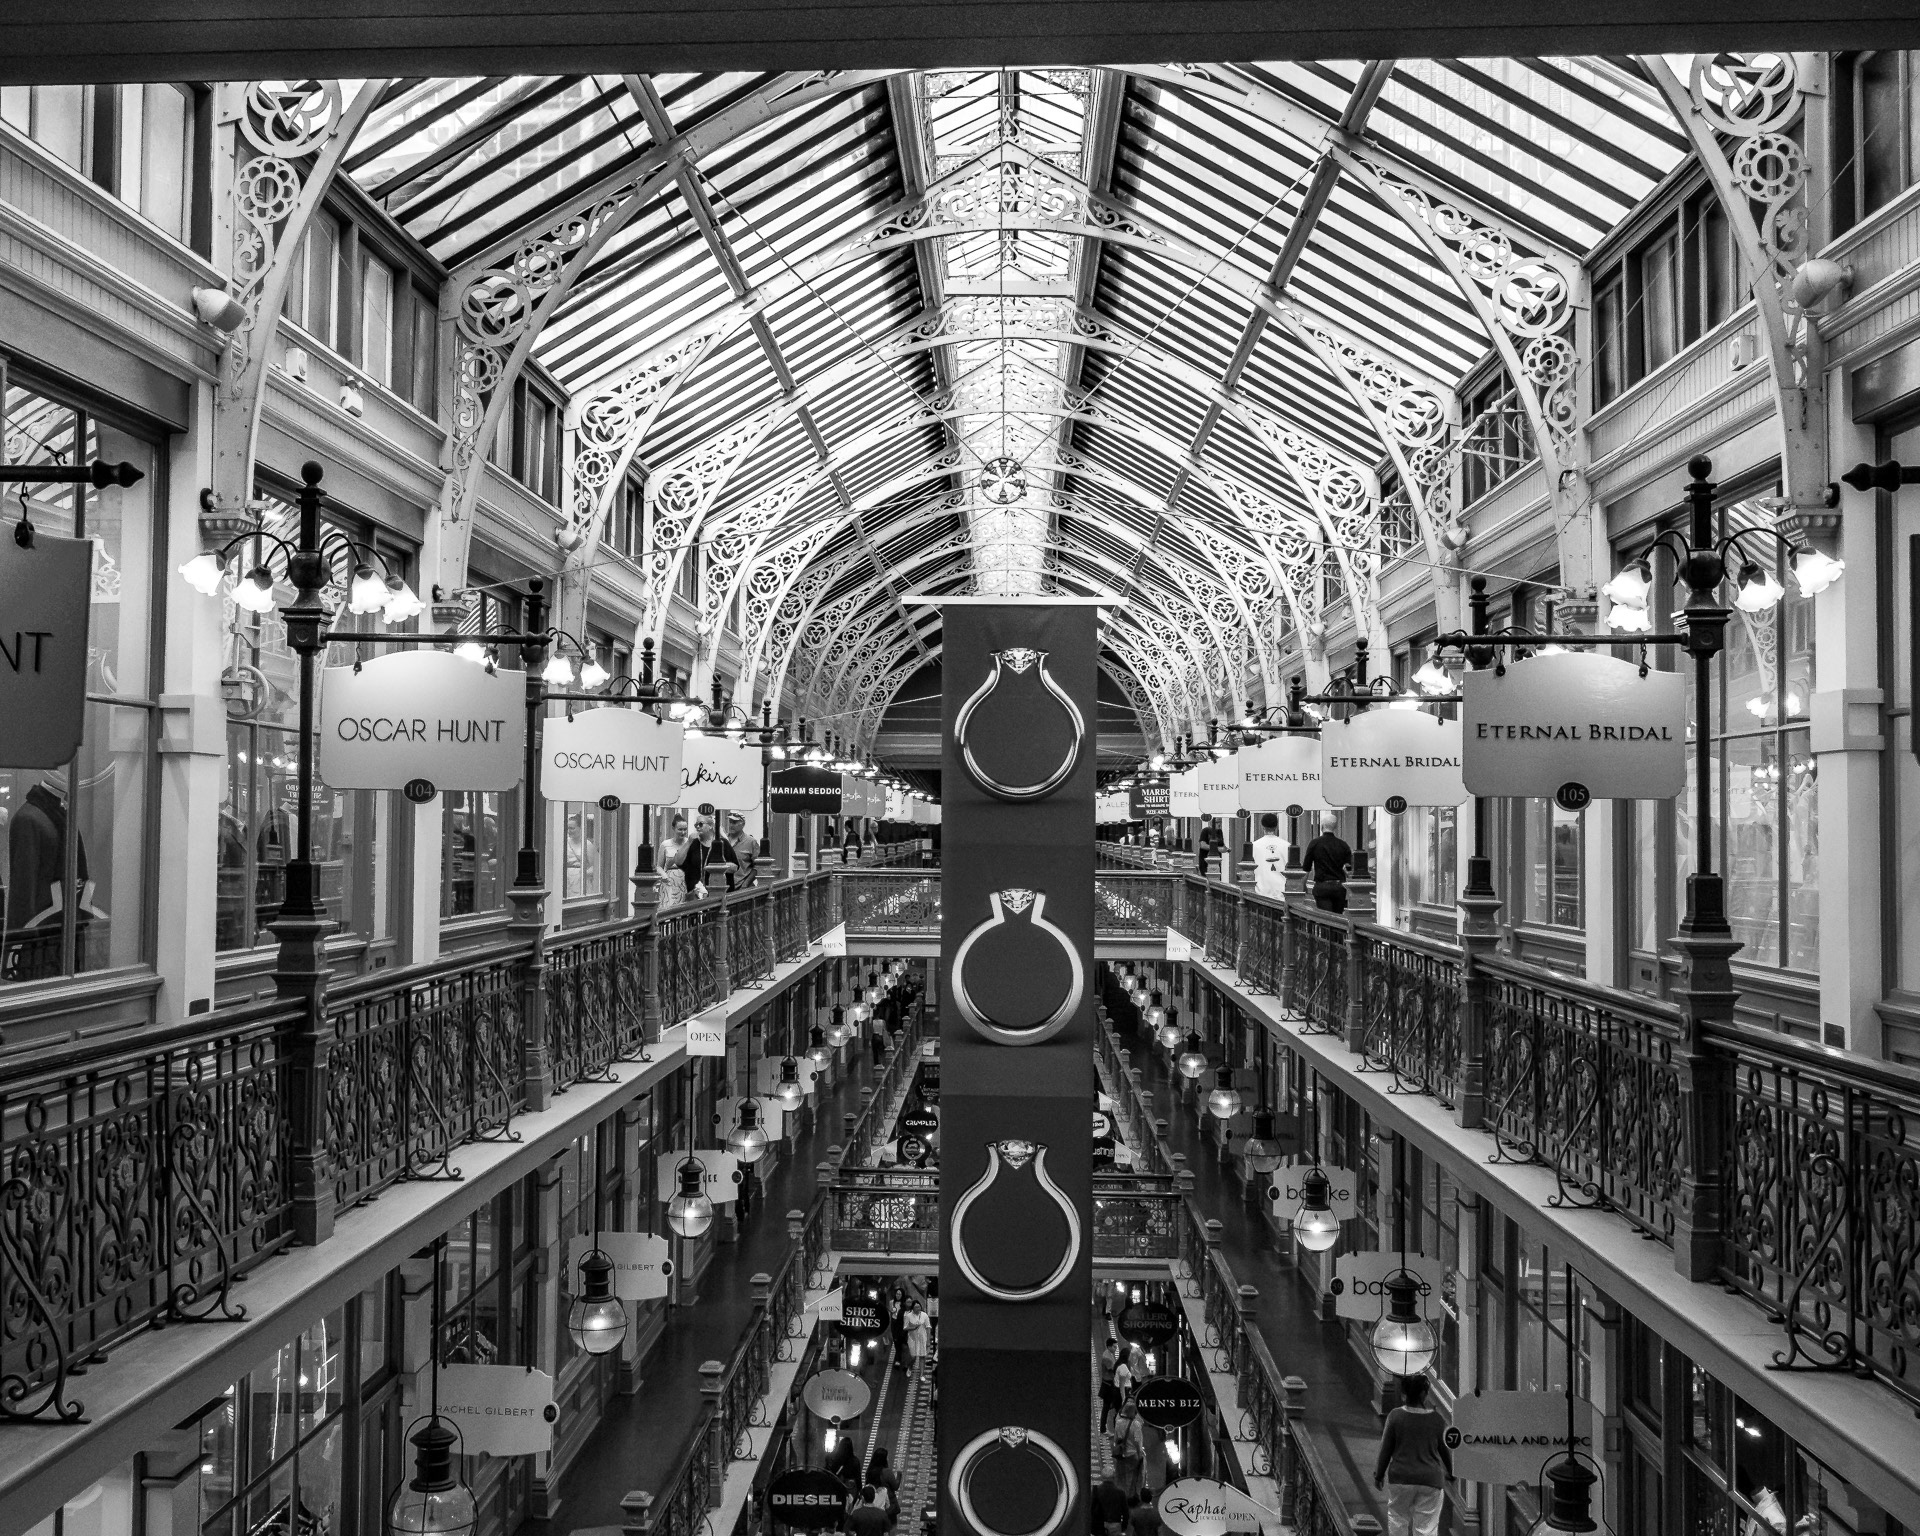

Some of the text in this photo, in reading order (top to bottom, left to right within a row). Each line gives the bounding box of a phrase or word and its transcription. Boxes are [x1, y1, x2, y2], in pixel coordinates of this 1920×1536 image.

[338, 717, 505, 743] OSCAR HUNT
[554, 752, 669, 772] OSCAR HUNT
[408, 784, 432, 797] 104
[1562, 788, 1585, 801] 105
[602, 798, 619, 808] 104
[1388, 800, 1404, 809] 107
[690, 1033, 721, 1042] OPEN
[617, 1263, 655, 1271] GILBERT
[846, 1306, 875, 1317] SHOE
[840, 1317, 880, 1328] SHINES
[1123, 1320, 1172, 1329] SHOPPING
[1138, 1399, 1200, 1407] MEN'S BIZ
[485, 1407, 535, 1416] GILBERT
[1447, 1433, 1459, 1444] 57
[1463, 1434, 1517, 1445] CAMILLA
[1521, 1435, 1549, 1446] AND
[772, 1494, 842, 1505] DIESEL
[1229, 1512, 1256, 1521] OPEN
